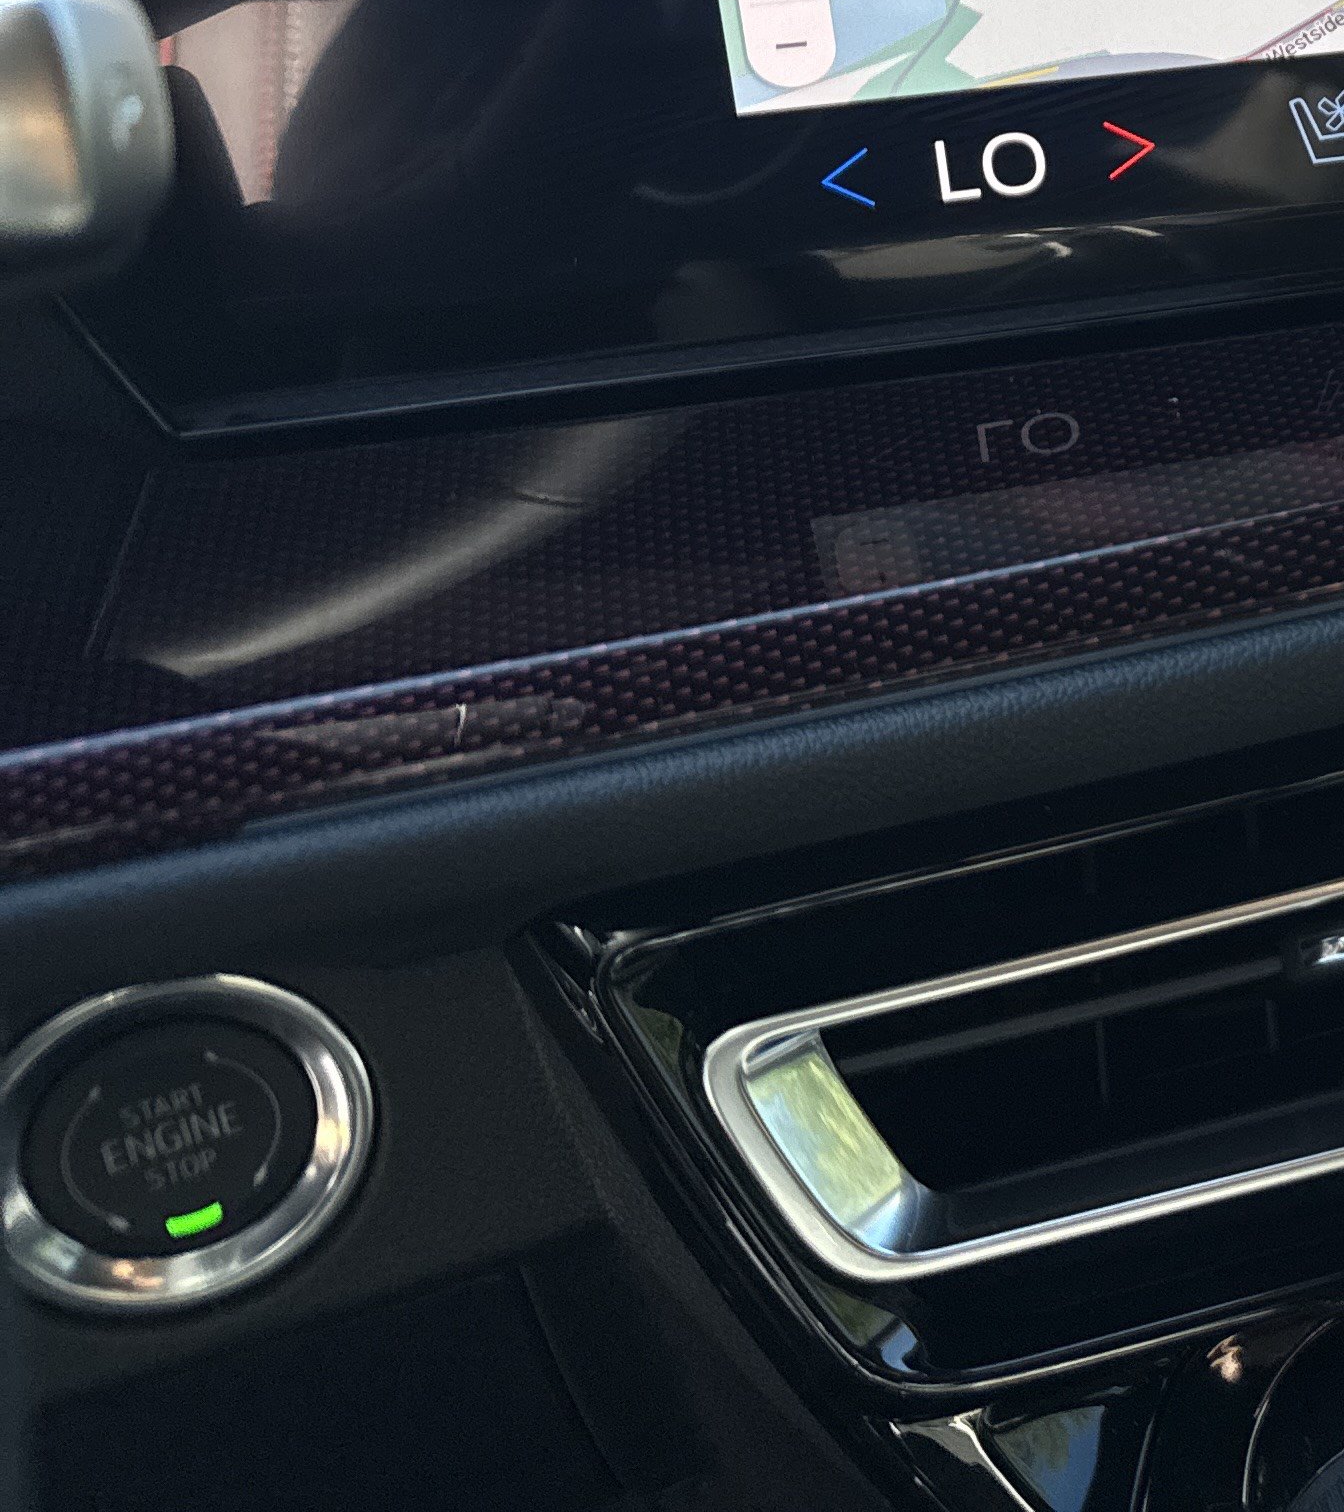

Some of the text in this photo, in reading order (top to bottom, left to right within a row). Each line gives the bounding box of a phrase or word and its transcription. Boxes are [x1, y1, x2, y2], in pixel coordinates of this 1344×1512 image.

[934, 131, 1047, 204] LO
[119, 1082, 203, 1127] START
[100, 1100, 244, 1177] ENGINE
[144, 1148, 217, 1188] STOP
